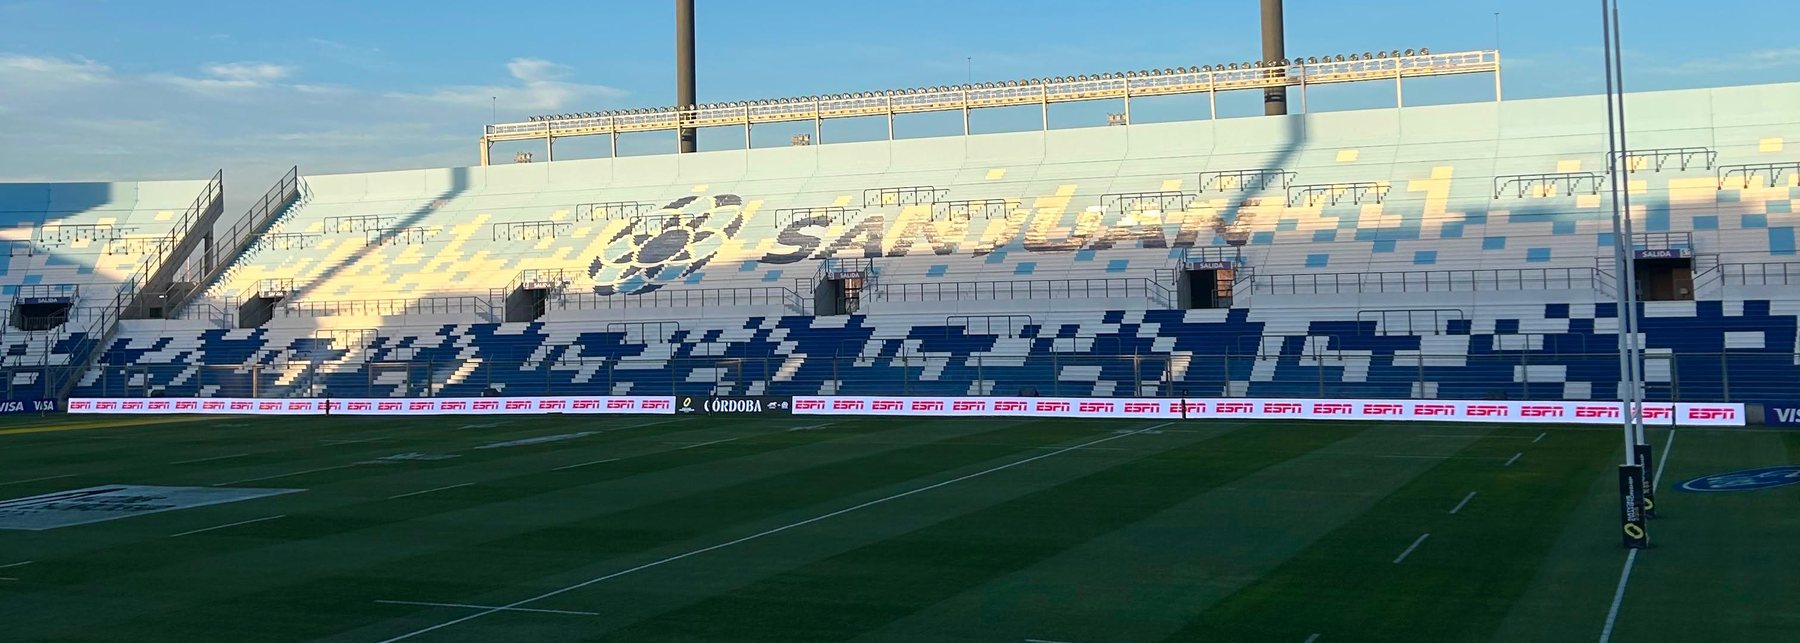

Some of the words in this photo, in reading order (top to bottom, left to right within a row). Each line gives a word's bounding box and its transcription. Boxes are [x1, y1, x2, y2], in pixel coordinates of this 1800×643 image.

[757, 212, 968, 264] SAN
[1642, 250, 1672, 258] SALIDA
[71, 401, 91, 409] ESPN
[96, 401, 117, 409] ESPN
[123, 401, 142, 409] ESPN
[149, 401, 170, 409] ESPN
[175, 401, 197, 409] ESPN
[203, 401, 223, 410] ESPN
[231, 401, 253, 410] ESPN
[260, 401, 281, 410] ESPN
[289, 401, 313, 410] ESPN
[348, 401, 371, 411] ESPN
[378, 401, 402, 411] ESPN
[409, 401, 434, 411] ESPN
[441, 401, 467, 410] ESPN
[472, 400, 500, 410] ESPN
[505, 400, 532, 410] ESPN
[539, 400, 564, 410] ESPN
[573, 399, 600, 409] ESPN
[607, 399, 634, 409] ESPN
[642, 399, 670, 409] ESPN
[703, 397, 762, 413] CÓRDOBA
[795, 399, 825, 410] ESPN
[833, 399, 864, 410] ESPN
[871, 400, 903, 411] ESPN
[911, 400, 944, 411] ESPN
[952, 400, 985, 412] ESPN
[993, 400, 1027, 412] ESPN
[1036, 401, 1068, 412] ESPN
[1079, 401, 1114, 413] ESPN
[1123, 402, 1160, 413] ESPN
[1215, 402, 1254, 414] ESPN
[1263, 402, 1302, 414] ESPN
[1312, 403, 1352, 415] ESPN
[1362, 403, 1404, 415] ESPN
[1413, 403, 1455, 416] ESPN
[1465, 404, 1508, 417] ESPN
[1520, 404, 1564, 417] ESPN
[1574, 405, 1619, 418] ESPN
[1632, 407, 1673, 420] SPN
[1688, 408, 1735, 420] ESPN
